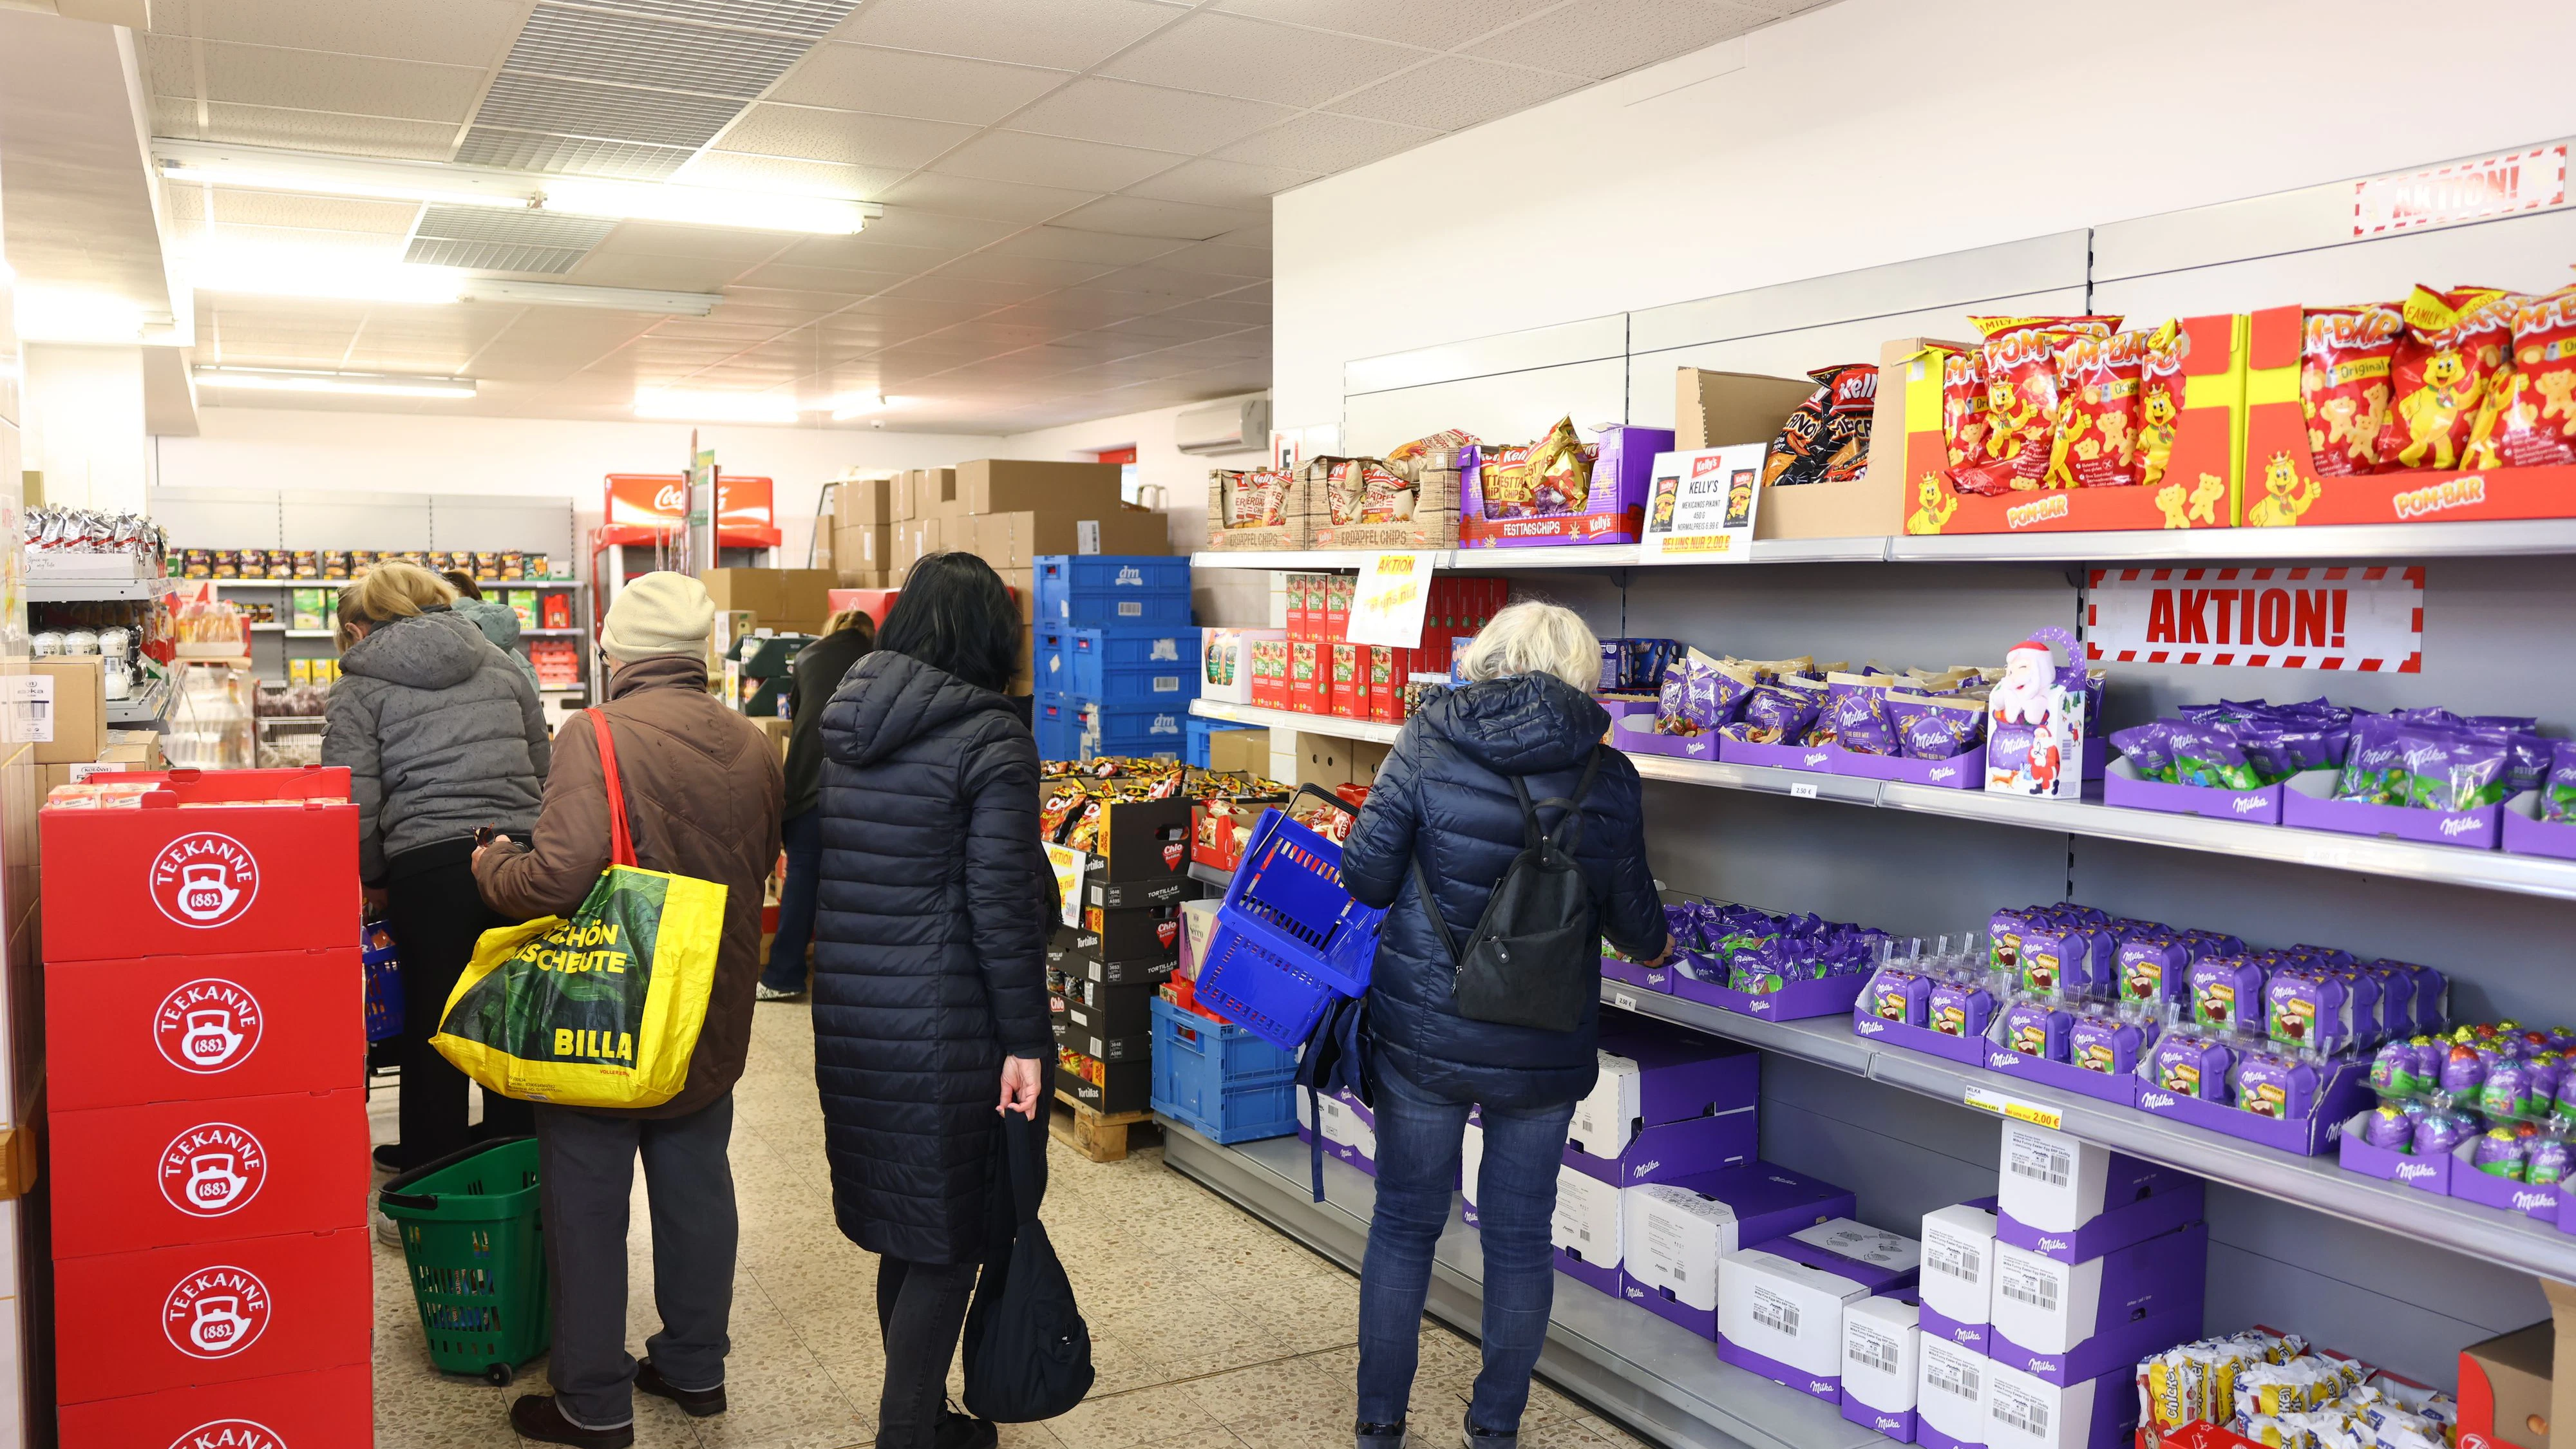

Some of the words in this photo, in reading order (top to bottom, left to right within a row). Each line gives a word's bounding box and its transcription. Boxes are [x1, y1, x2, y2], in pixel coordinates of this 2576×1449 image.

[2392, 165, 2520, 219] AKTION!
[2405, 307, 2439, 326] FAMILY
[2340, 362, 2385, 379] Original
[1696, 457, 1718, 473] Kelly's
[1689, 480, 1719, 495] KELLY'S
[1681, 500, 1705, 509] MEXICANOS
[2395, 477, 2485, 518] POM-BAR
[1589, 515, 1611, 532] Kelly's
[1341, 529, 1378, 546] ERDÄPFEL
[1662, 538, 1674, 551] BEI
[1675, 537, 1690, 550] UNS
[1692, 536, 1705, 549] NUR
[1725, 535, 1731, 549] €
[1119, 565, 1140, 578] dm
[1378, 558, 1416, 574] AKTION
[1380, 593, 1398, 608] uns
[1400, 586, 1417, 603] nur
[2146, 587, 2348, 648] AKTION!
[1154, 714, 1175, 726] dm
[1840, 709, 1869, 727] Milka
[1912, 732, 1949, 748] Milka
[2001, 737, 2031, 754] Milka
[2170, 734, 2199, 749] Milka
[1686, 743, 1705, 755] Milka
[1804, 752, 1828, 766] Milka
[1929, 767, 1956, 782] Milka
[2233, 795, 2268, 813] Milka
[2440, 817, 2483, 837] Milka
[1164, 843, 1184, 855] Chio
[157, 840, 252, 886] TEEKANNE
[1049, 849, 1074, 865] AKTION
[1065, 879, 1075, 889] nur
[1148, 886, 1178, 897] TORTILLAS
[191, 893, 221, 907] 1882
[1158, 921, 1177, 933] Chio
[1992, 923, 2011, 933] Milka
[1077, 936, 1097, 949] Tortillas
[2023, 943, 2043, 954] Milka
[2123, 951, 2145, 961] Milka
[1148, 960, 1177, 974] TORTILLAS
[1647, 972, 1665, 985] Milka
[2195, 972, 2217, 983] Milka
[1876, 981, 1894, 994] Milka
[2273, 986, 2297, 998] Milka
[1050, 997, 1064, 1011] Chio
[1749, 999, 1770, 1012] Milka
[1933, 996, 1951, 1006] Milka
[161, 986, 256, 1032] TEEKANNE
[1858, 1021, 1884, 1034] Milka
[2011, 1015, 2031, 1027] Milka
[195, 1039, 225, 1052] 1882
[554, 1028, 632, 1061] BILLA
[2075, 1034, 2096, 1045] Milka
[1990, 1052, 2020, 1066] Milka
[2161, 1052, 2183, 1063] Milka
[2242, 1070, 2267, 1082] Milka
[1078, 1087, 1099, 1097] Tortillas
[1965, 1099, 1988, 1108] Originalpreis
[2142, 1092, 2175, 1109] Milka
[2033, 1112, 2052, 1125] 2,00
[2054, 1118, 2060, 1127] €
[166, 1130, 260, 1178] TEEKANNE
[1340, 1148, 1352, 1157] Milka
[1634, 1159, 1660, 1178] Milka
[2396, 1162, 2437, 1180] Milka
[199, 1182, 229, 1196] 1882
[2513, 1191, 2557, 1210] Milka
[2038, 1237, 2068, 1253] Milka
[170, 1273, 264, 1321] TEEKANNE
[1625, 1286, 1643, 1298] Milka
[204, 1324, 234, 1339] 1882
[1955, 1328, 1981, 1342] Milka
[2028, 1358, 2057, 1373] Milka
[1810, 1380, 1834, 1394] Milka
[1875, 1416, 1900, 1429] Milka
